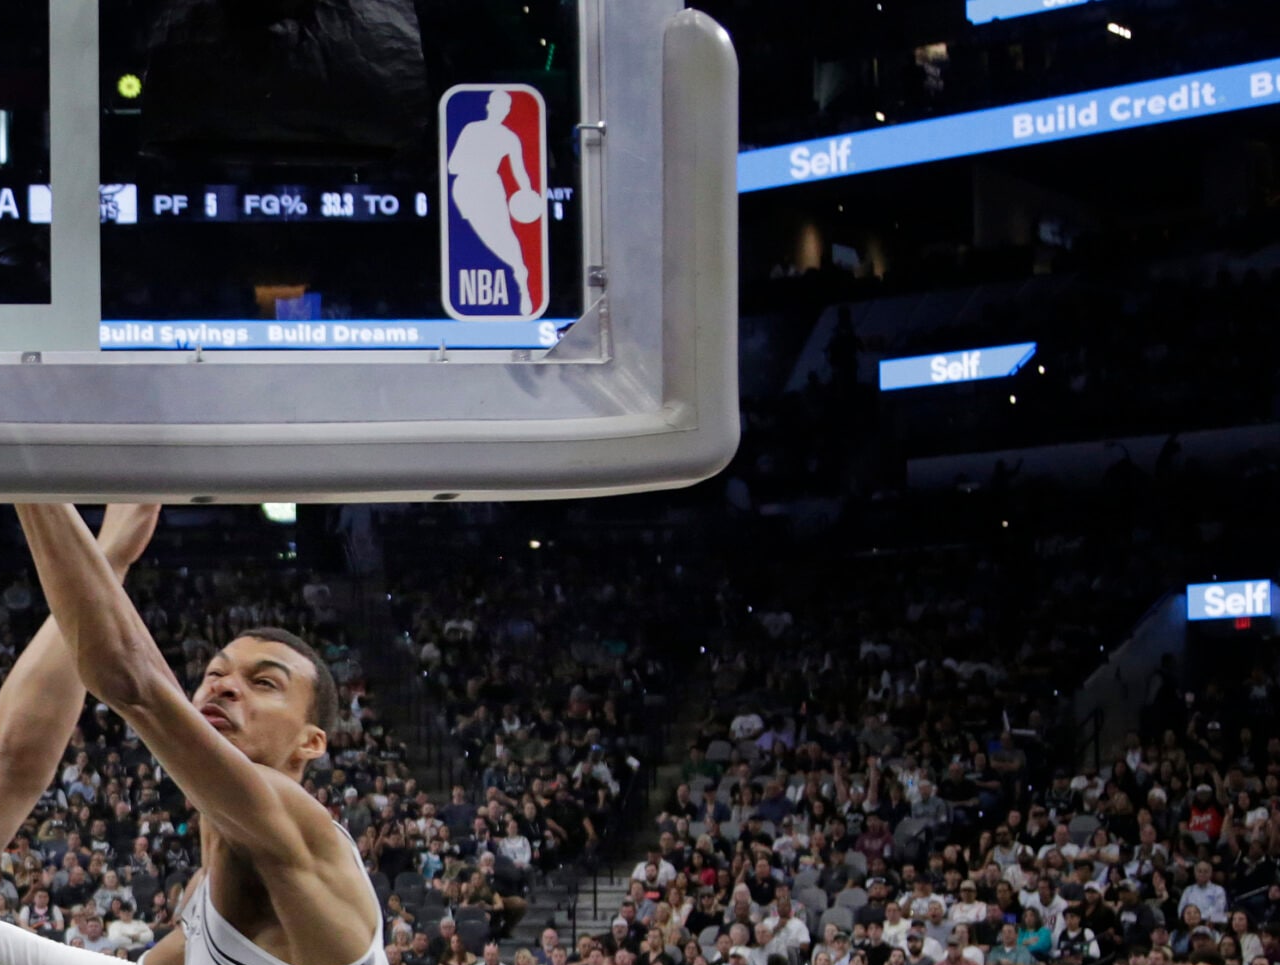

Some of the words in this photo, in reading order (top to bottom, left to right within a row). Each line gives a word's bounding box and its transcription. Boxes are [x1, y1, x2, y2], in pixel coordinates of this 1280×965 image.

[1012, 101, 1098, 139] Build
[1109, 81, 1217, 122] Credit
[790, 137, 852, 180] Self
[154, 194, 188, 215] PF
[244, 194, 308, 215] FG%
[364, 194, 399, 215] TO
[459, 268, 510, 306] NBA
[160, 326, 249, 346] Savings
[267, 324, 327, 342] Build
[333, 325, 419, 342] Dreams
[931, 350, 981, 382] Self
[1204, 582, 1268, 617] Self
